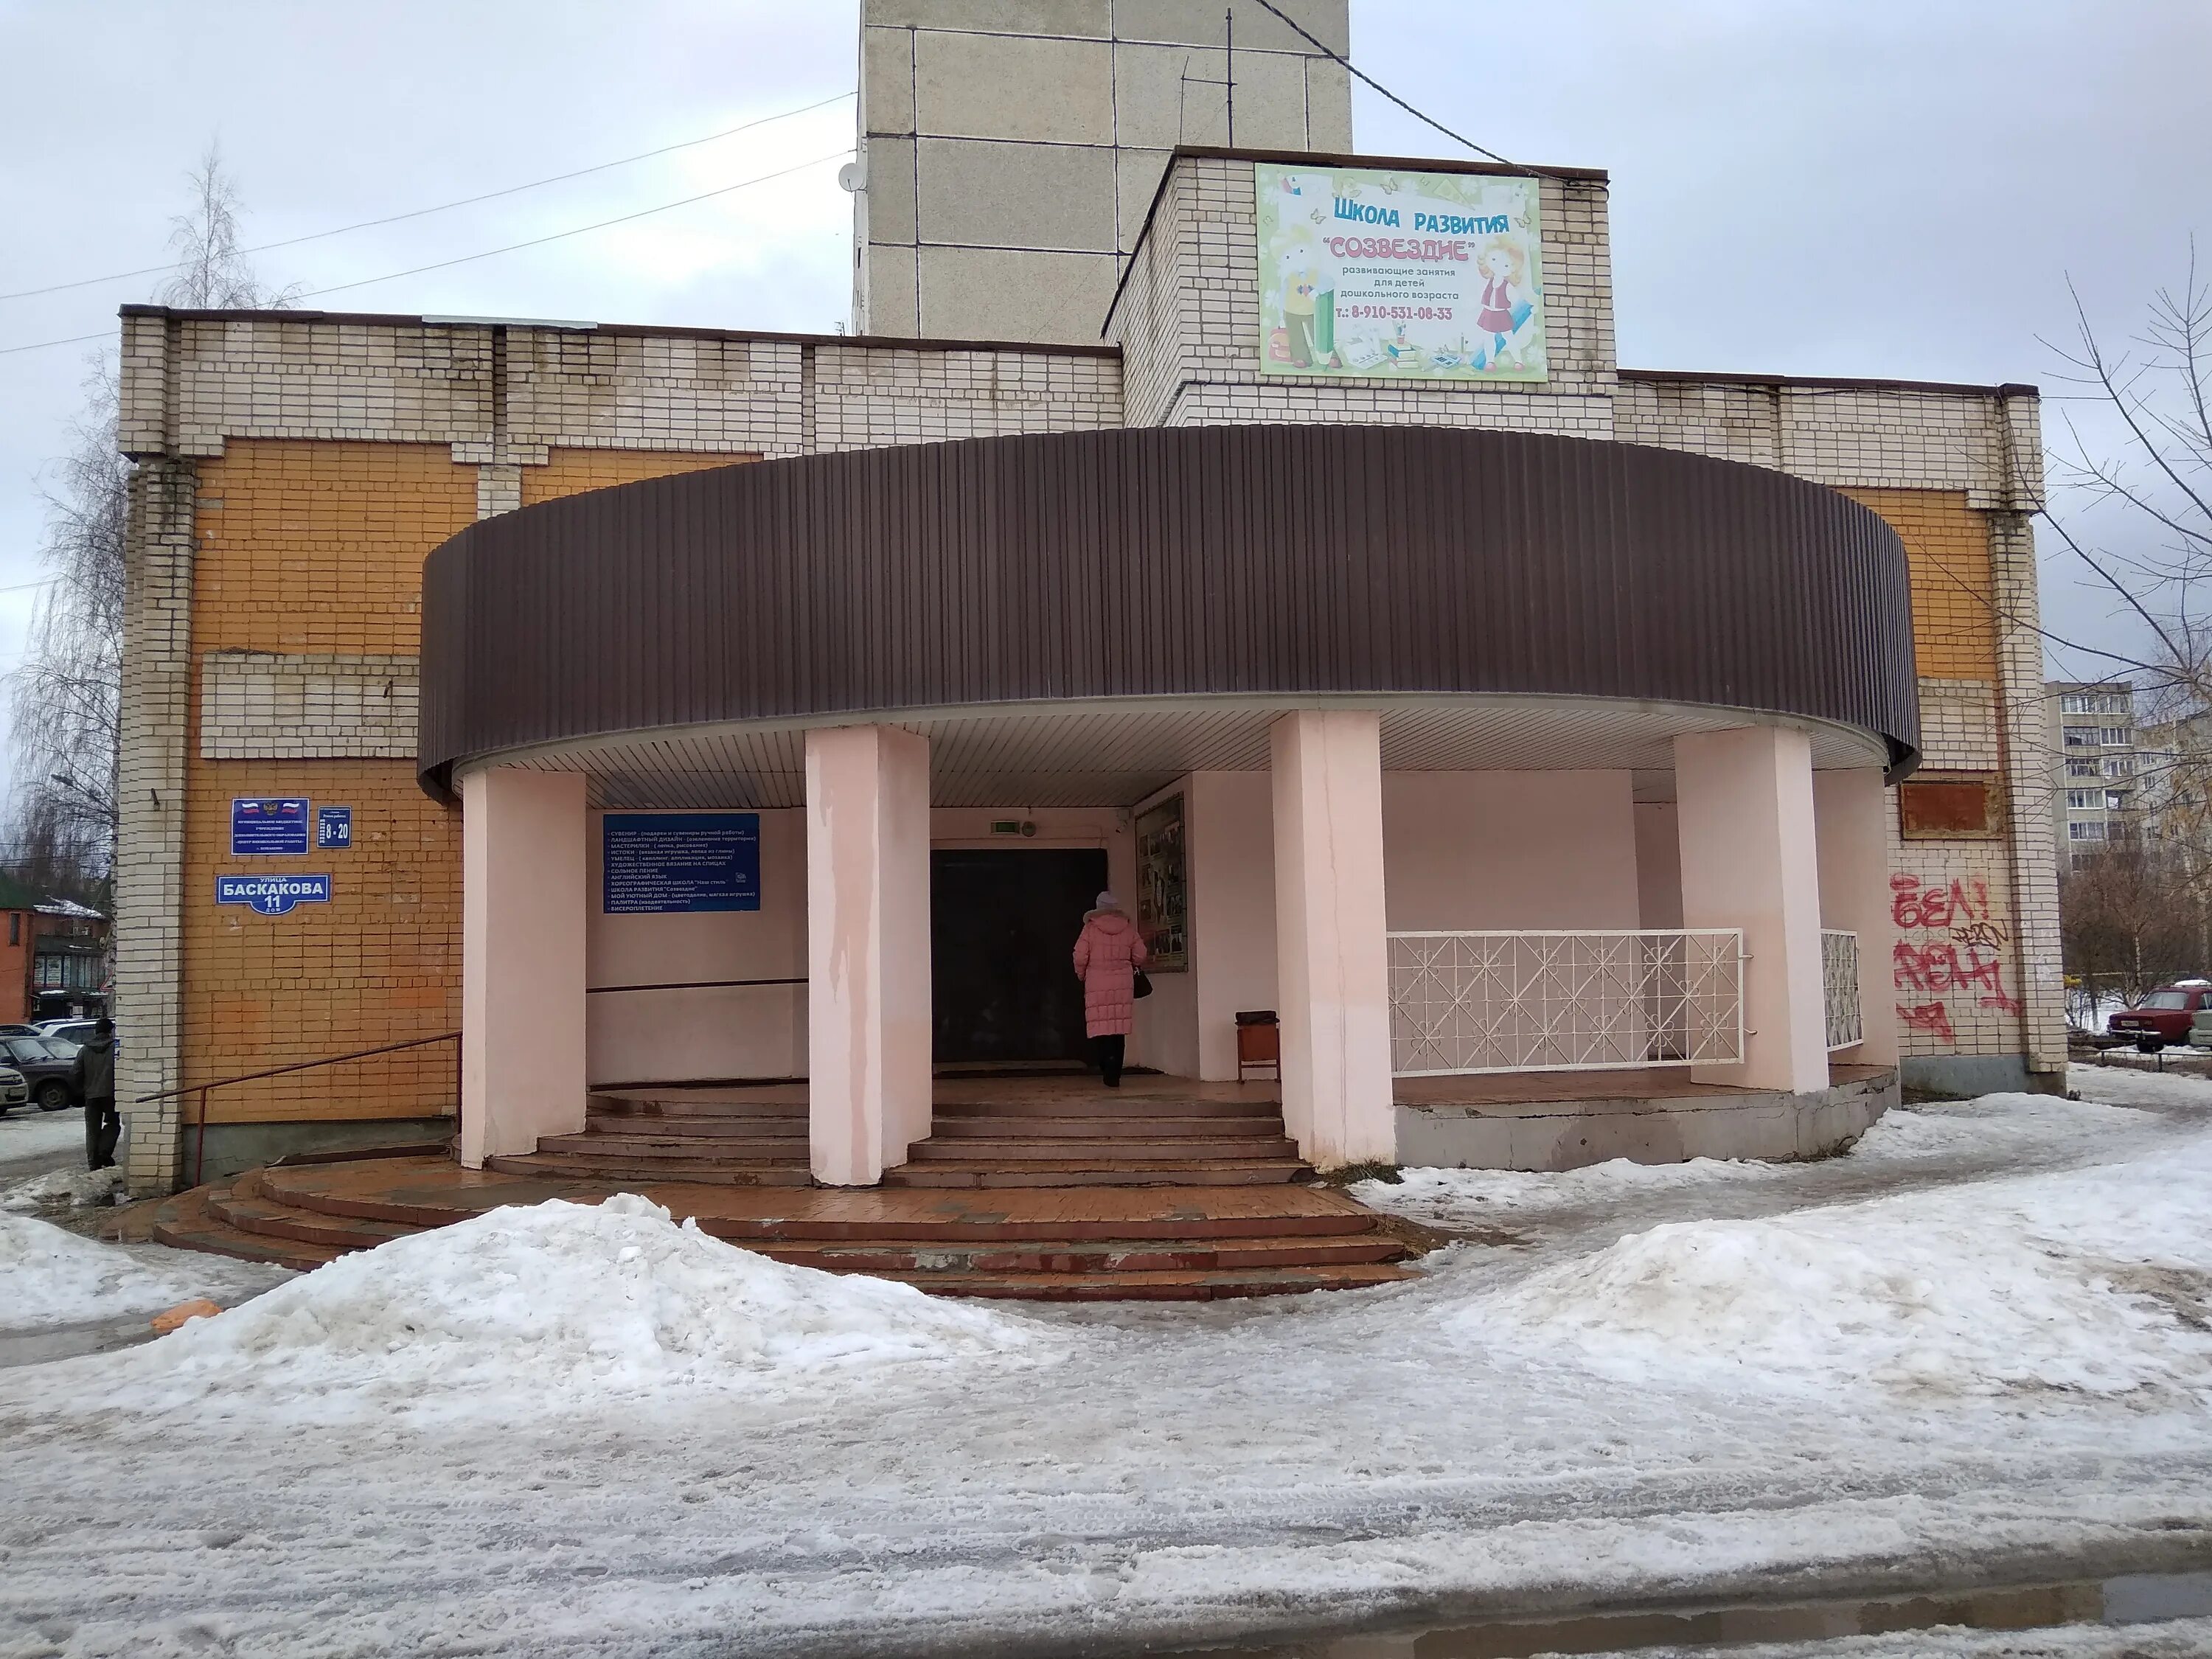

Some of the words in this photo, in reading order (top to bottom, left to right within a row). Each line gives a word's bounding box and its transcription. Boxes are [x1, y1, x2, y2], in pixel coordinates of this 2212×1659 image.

[1414, 212, 1509, 234] РАЗВИТИЯ
[1342, 267, 1414, 276] развивающие
[1416, 268, 1455, 276] занятия
[1374, 279, 1392, 287] для
[1395, 279, 1425, 288] детей
[1340, 290, 1409, 299] дошкольного
[1411, 291, 1459, 301] возраста
[1336, 307, 1349, 318] т.:
[1352, 305, 1453, 320] 8-910-531-08-33
[326, 823, 331, 839] 8
[338, 823, 348, 839] 20
[223, 883, 323, 895] БАСКАКОВА
[264, 895, 280, 908] 11
